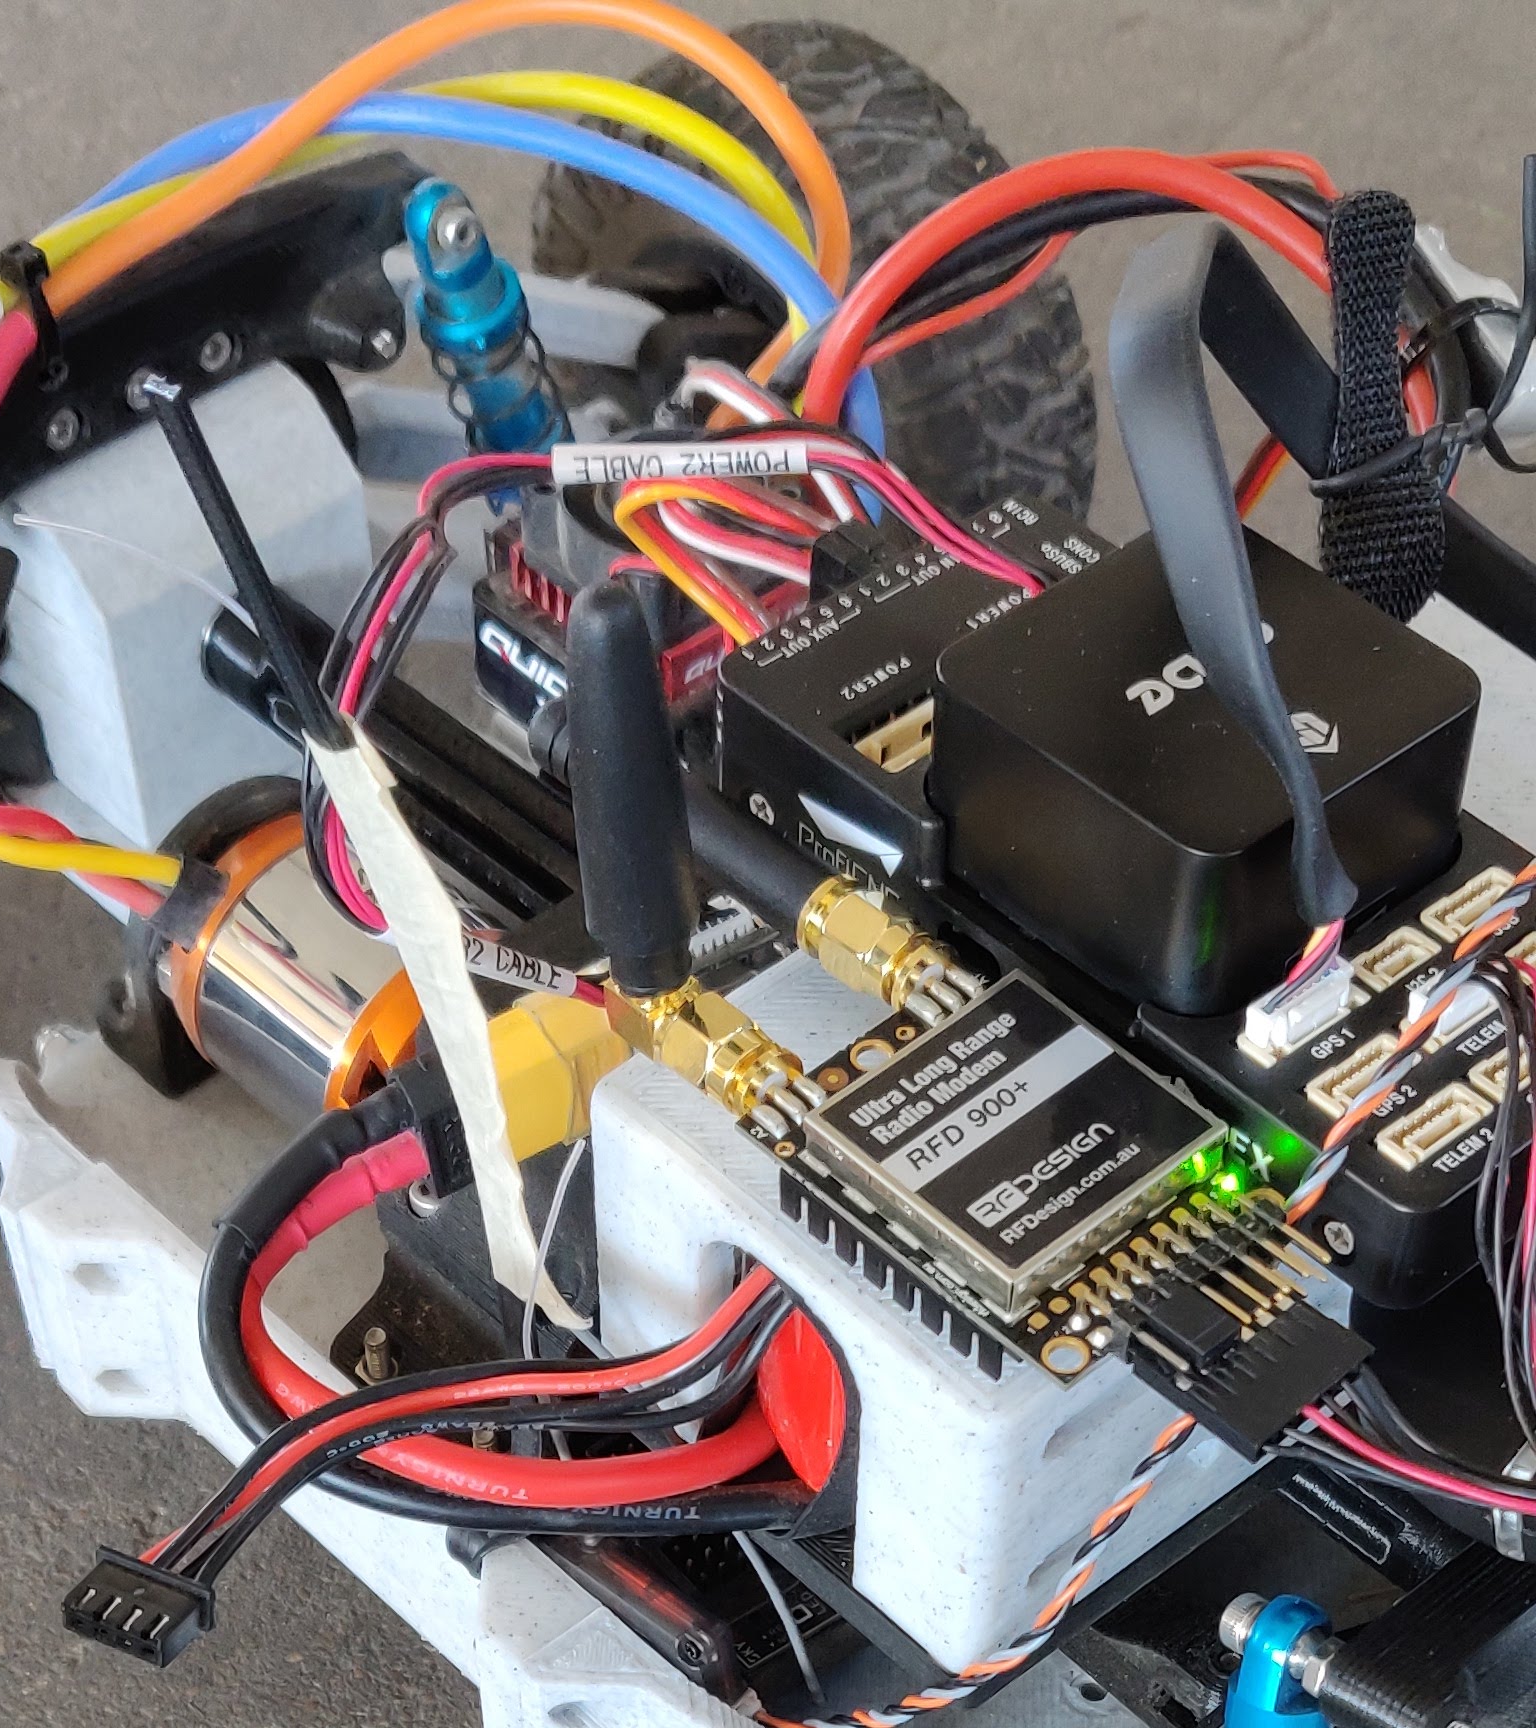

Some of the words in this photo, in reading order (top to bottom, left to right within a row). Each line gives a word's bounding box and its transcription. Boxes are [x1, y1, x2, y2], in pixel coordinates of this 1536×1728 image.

[573, 453, 664, 482] CABLE
[680, 448, 790, 476] POWER2
[781, 635, 812, 658] OUT
[809, 617, 841, 642] AUX
[840, 654, 912, 701] POWER2
[496, 945, 562, 989] CABLE
[1310, 1034, 1348, 1060] GPS
[848, 1088, 907, 1128] Ultra
[899, 1053, 959, 1094] Long
[948, 1012, 1017, 1061] Range
[869, 1100, 935, 1146] Radio
[926, 1050, 1009, 1105] Modem
[905, 1125, 965, 1172] RFD
[967, 1080, 1029, 1129] 900+
[1431, 1136, 1488, 1173] TELEM
[999, 1142, 1142, 1247] RFDesign.com.au
